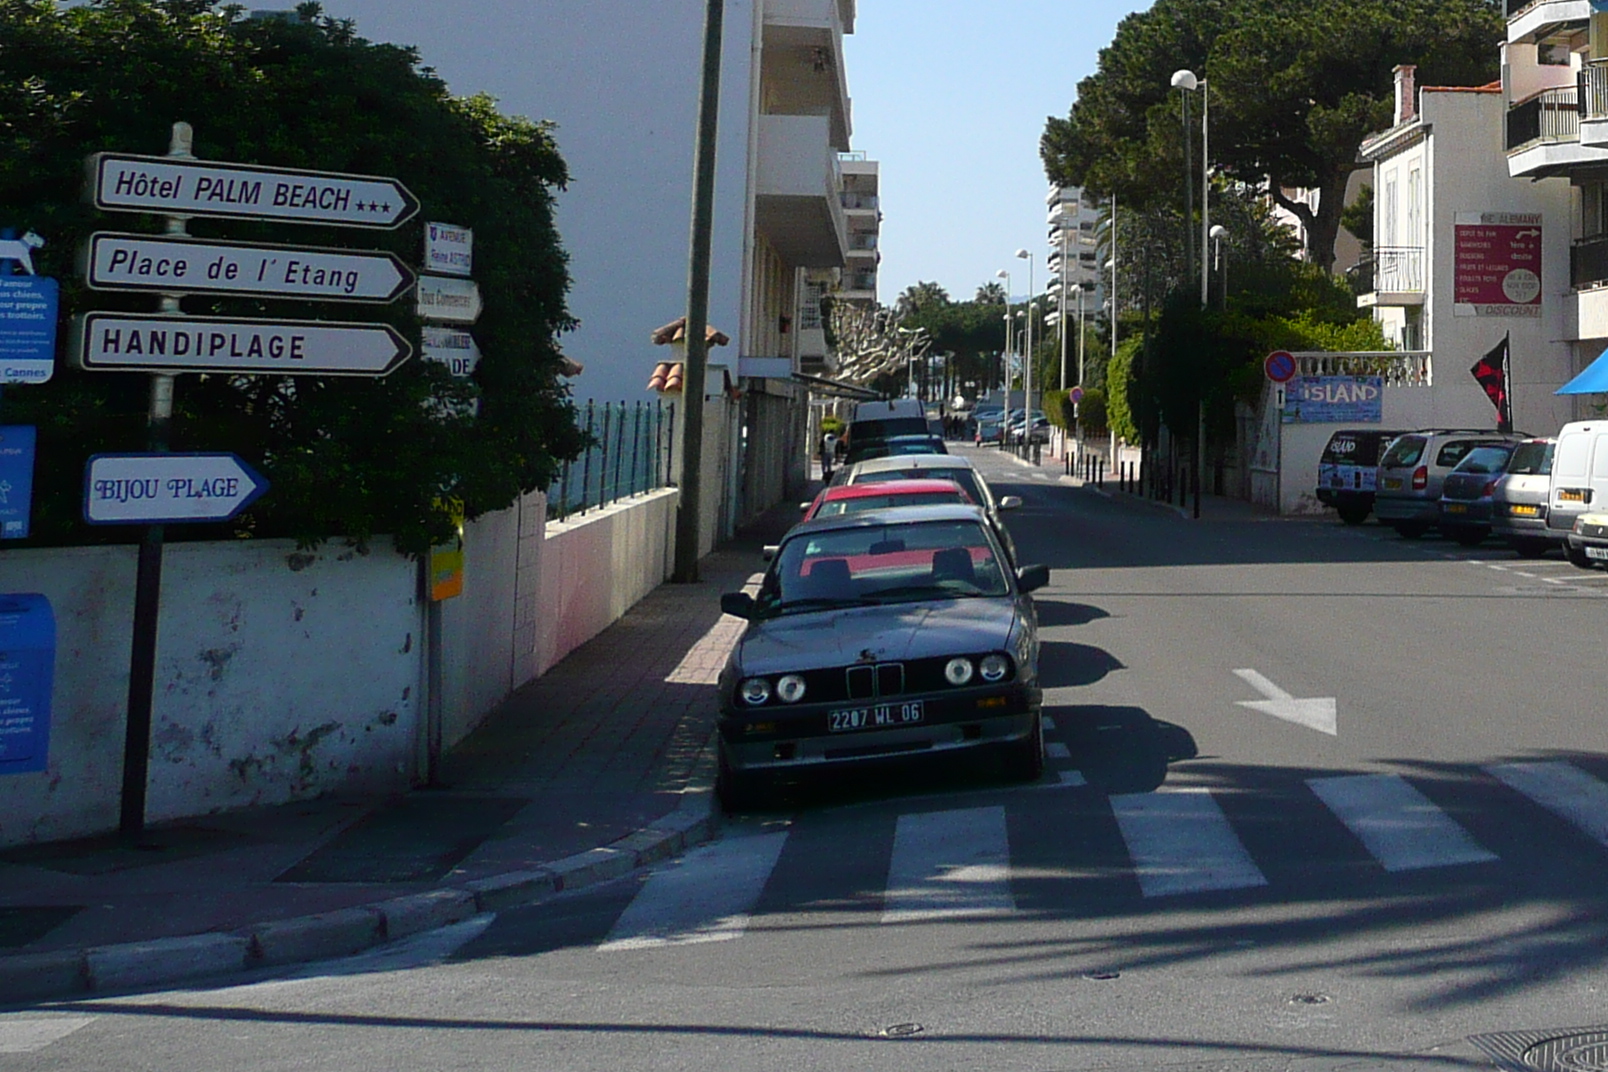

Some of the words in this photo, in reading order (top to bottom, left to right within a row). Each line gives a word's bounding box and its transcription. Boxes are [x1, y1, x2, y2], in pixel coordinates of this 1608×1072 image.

[115, 170, 182, 199] Hôtel
[194, 176, 261, 204] PALM
[272, 183, 351, 212] BEACH
[441, 229, 465, 244] AVENUE
[108, 249, 188, 277] Place
[207, 256, 239, 281] de
[16, 302, 47, 310] propre
[1485, 304, 1541, 317] DISCOUNT
[102, 329, 305, 360] HANDIPLAGE
[5, 367, 46, 377] Cannes
[94, 479, 159, 503] BIJOU
[167, 478, 239, 498] PLAGE
[875, 707, 894, 724] WL
[901, 703, 919, 721] 06
